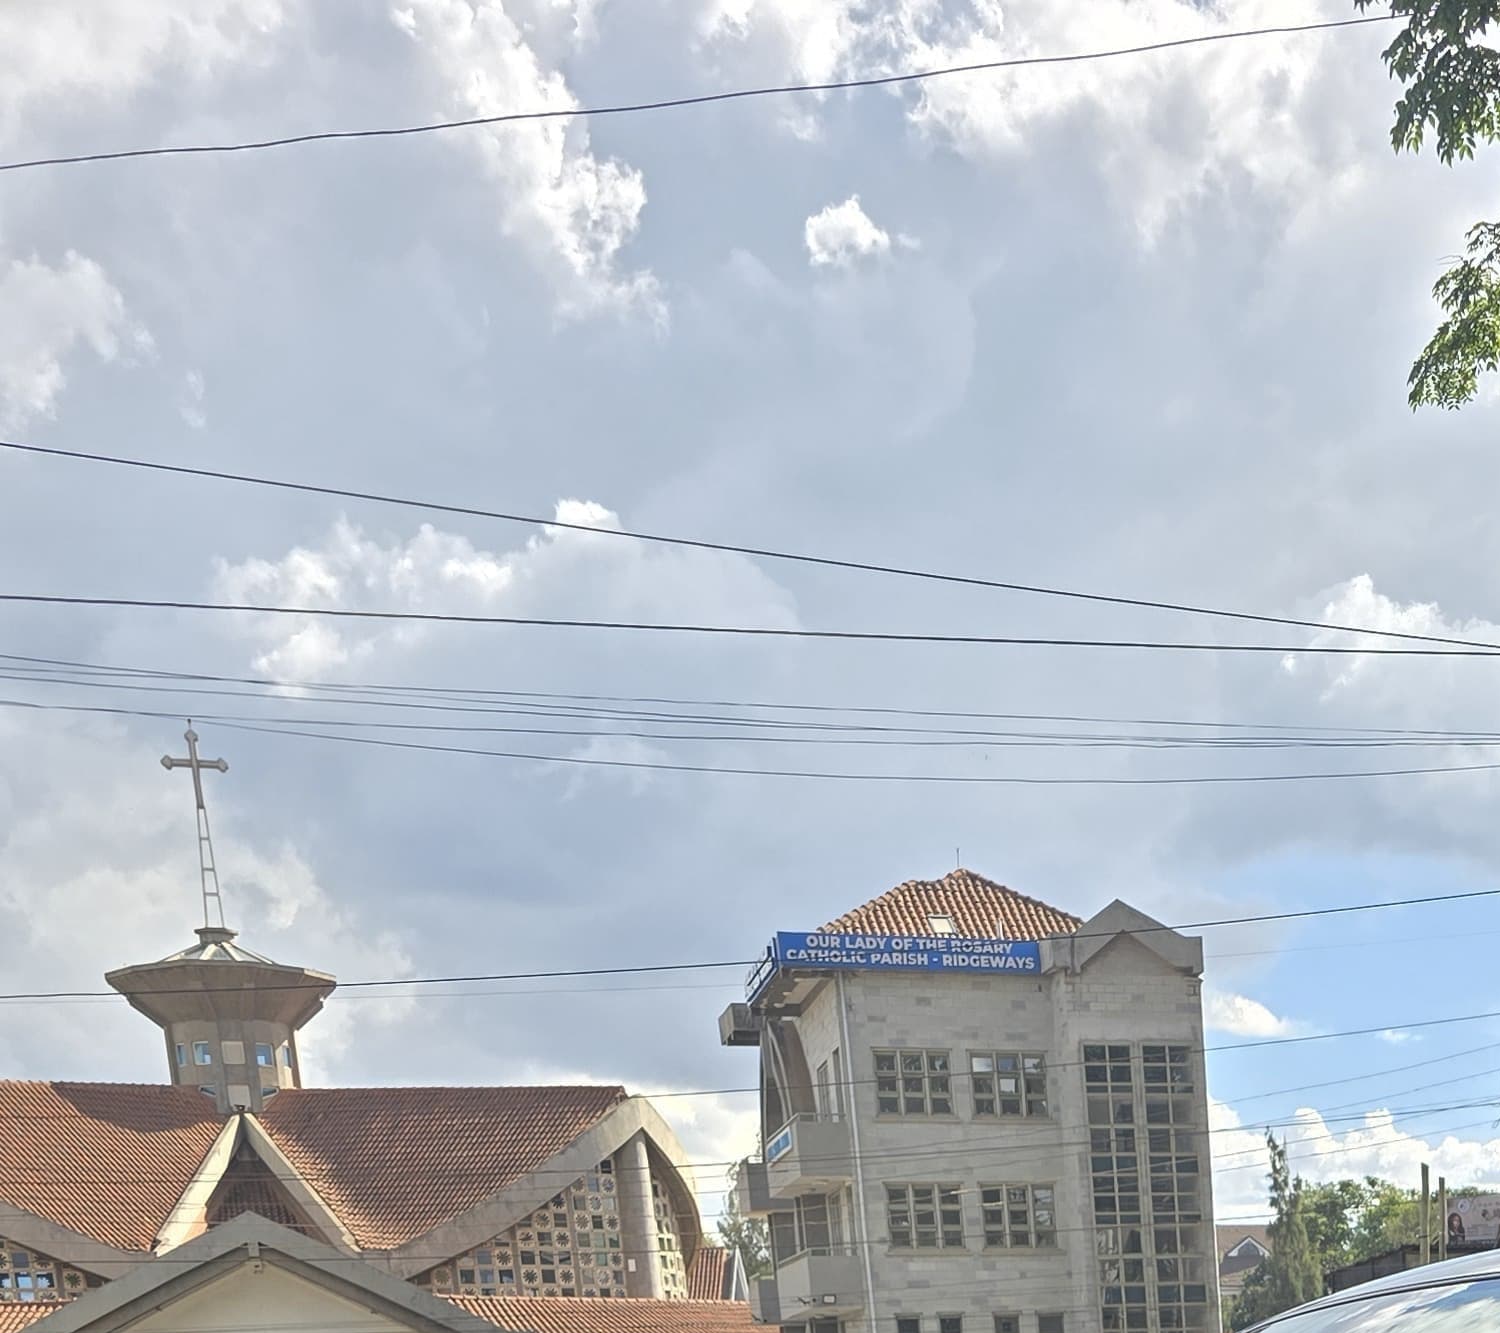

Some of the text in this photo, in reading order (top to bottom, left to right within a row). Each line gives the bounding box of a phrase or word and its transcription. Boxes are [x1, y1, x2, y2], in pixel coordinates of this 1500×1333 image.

[806, 935, 1013, 954] OUR LADY OF THE ROSARY
[786, 949, 867, 964] CATHOLIC
[870, 952, 928, 966] PARISH
[942, 954, 1035, 969] RIDGEWAYS
